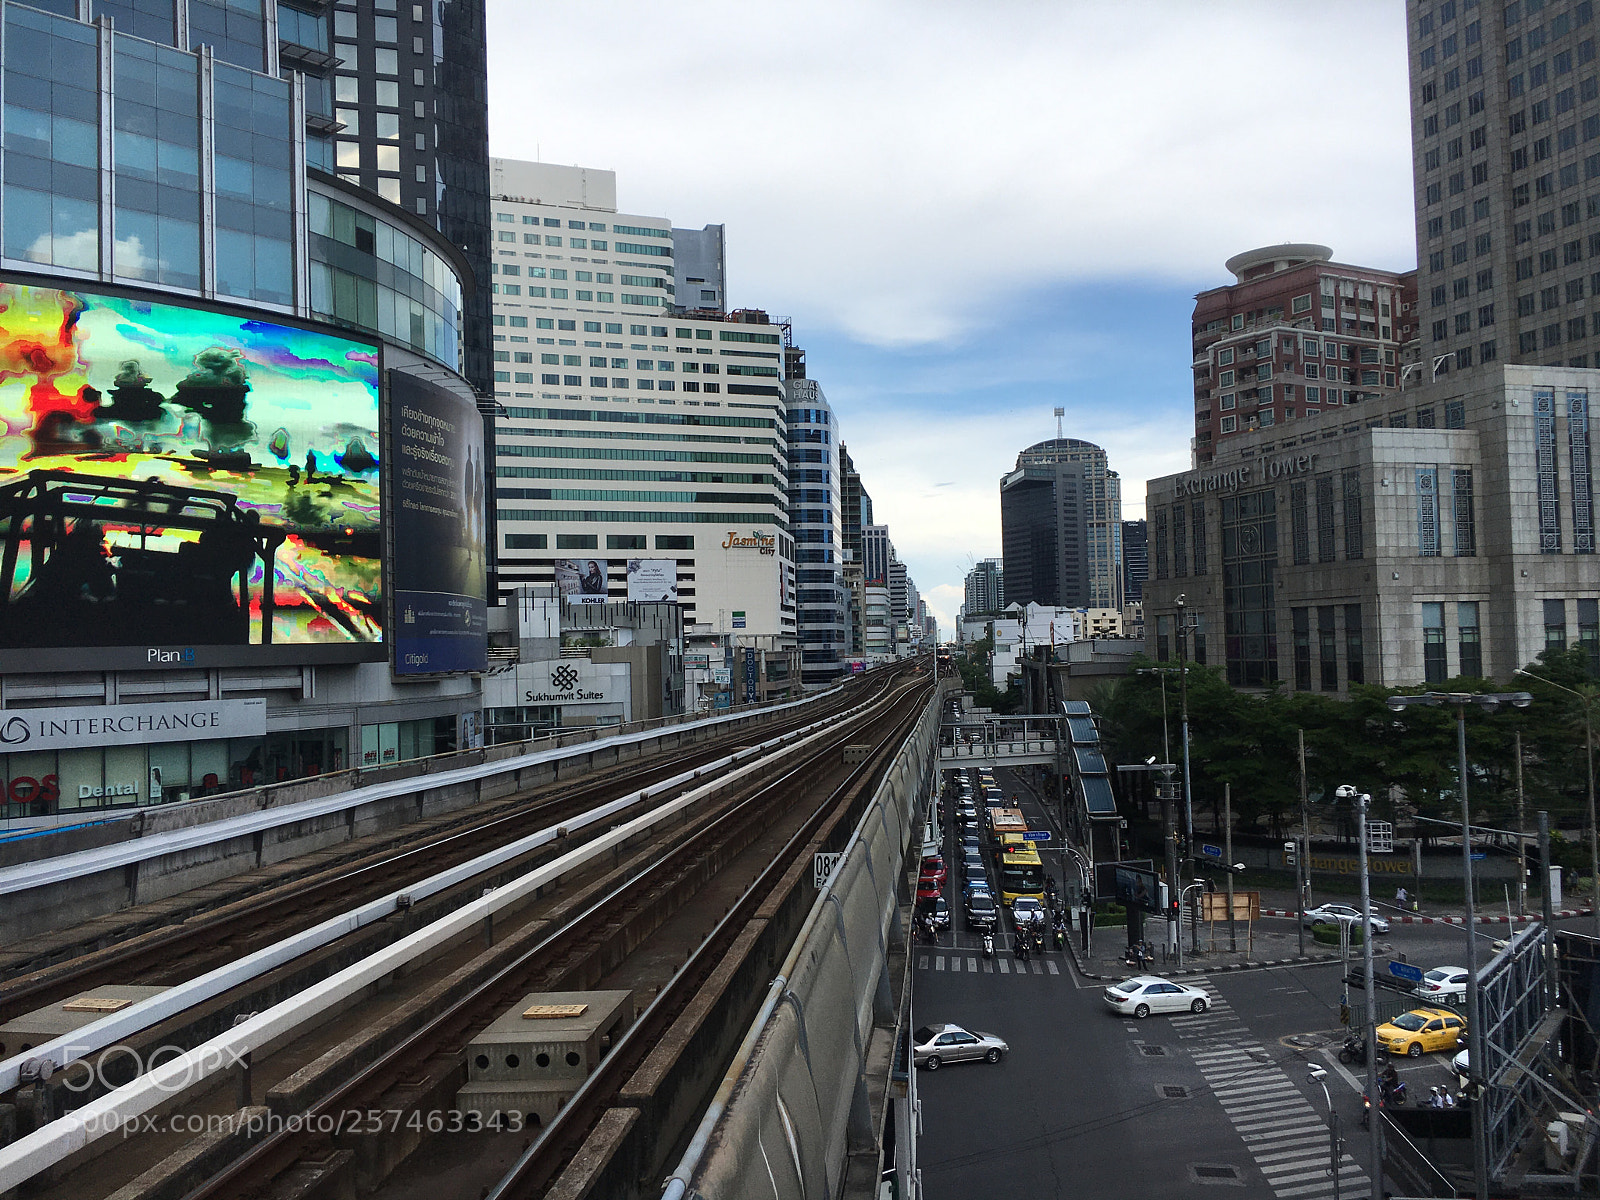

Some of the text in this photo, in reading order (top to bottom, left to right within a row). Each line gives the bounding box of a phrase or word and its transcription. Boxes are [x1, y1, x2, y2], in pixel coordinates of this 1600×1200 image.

[1174, 453, 1319, 498] Exchange Tower
[722, 531, 775, 548] Jasmine
[760, 548, 776, 557] City
[404, 652, 429, 666] Citigold
[526, 689, 604, 702] Sukhumvit Suites
[40, 711, 220, 738] INTERCHANGE
[78, 780, 139, 799] Dental
